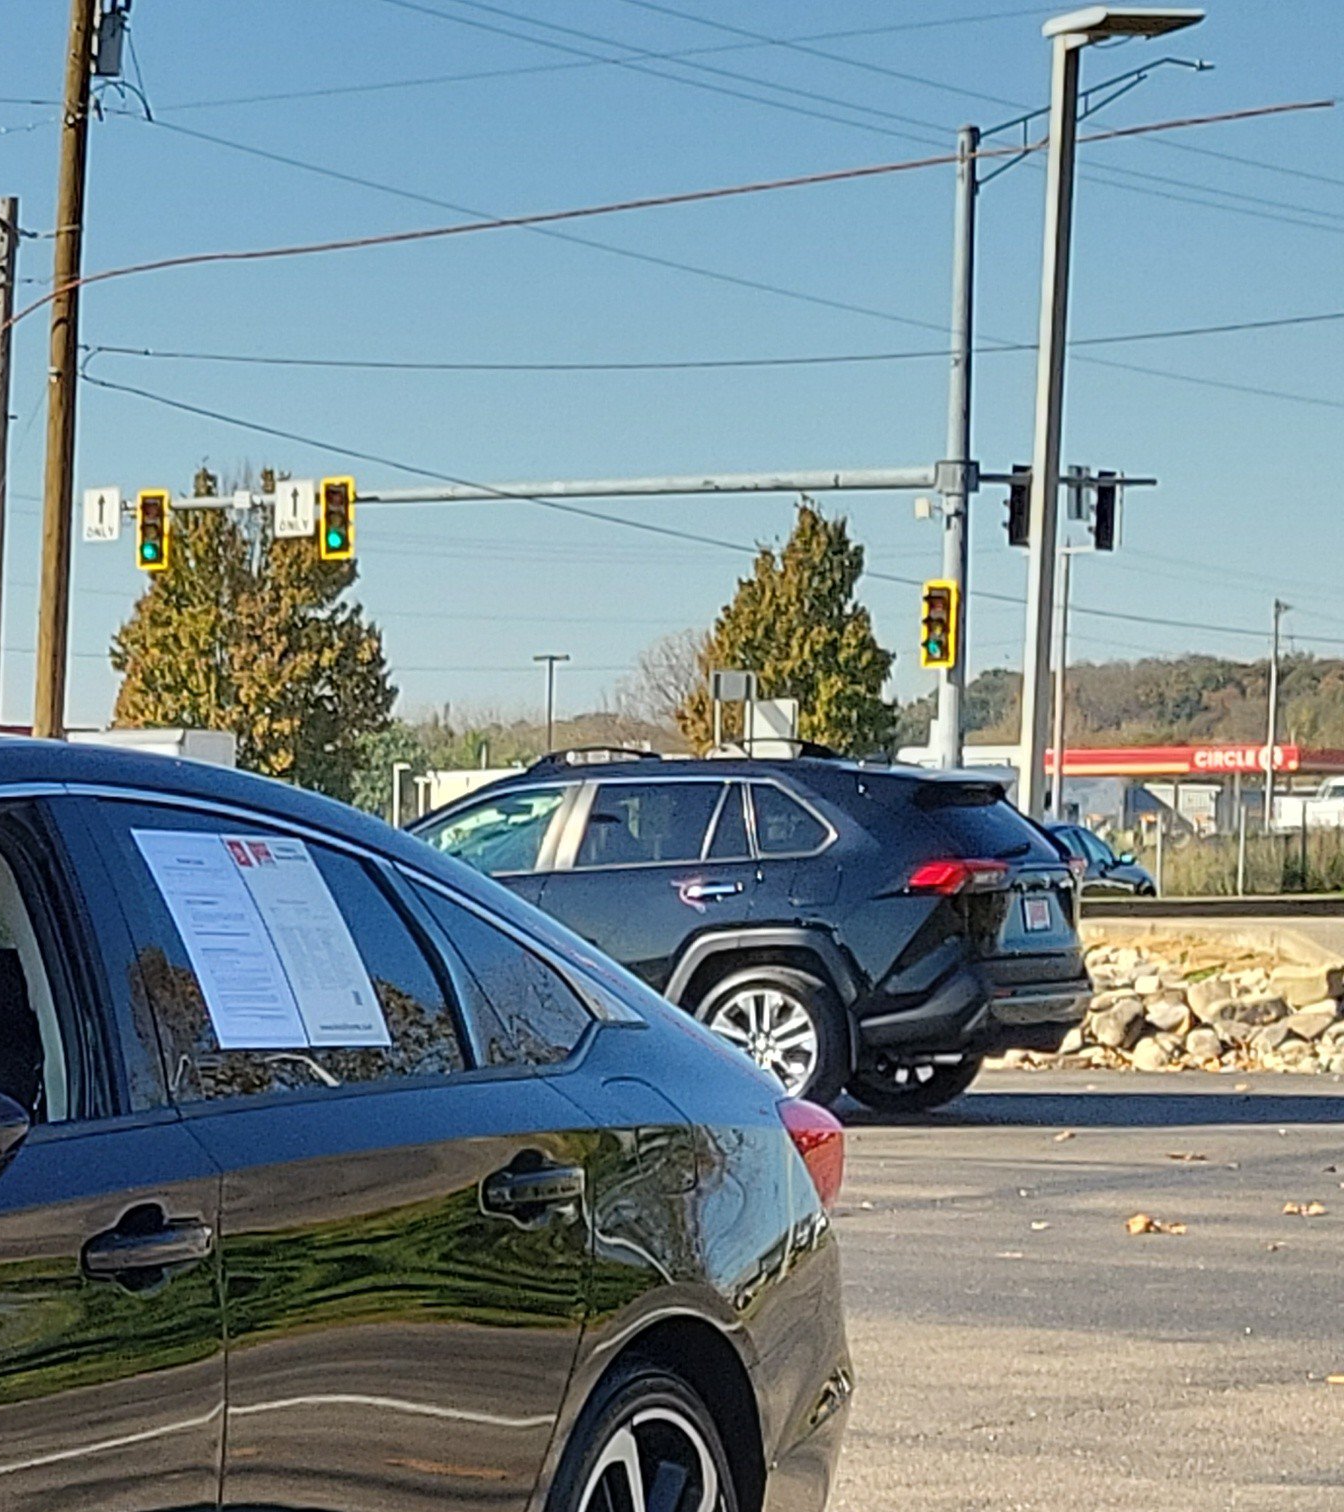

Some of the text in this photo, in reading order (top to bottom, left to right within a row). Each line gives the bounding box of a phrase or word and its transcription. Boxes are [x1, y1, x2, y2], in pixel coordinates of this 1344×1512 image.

[86, 525, 115, 538] ONLY
[279, 518, 310, 532] ONLY
[1194, 750, 1256, 768] CIRCLE
